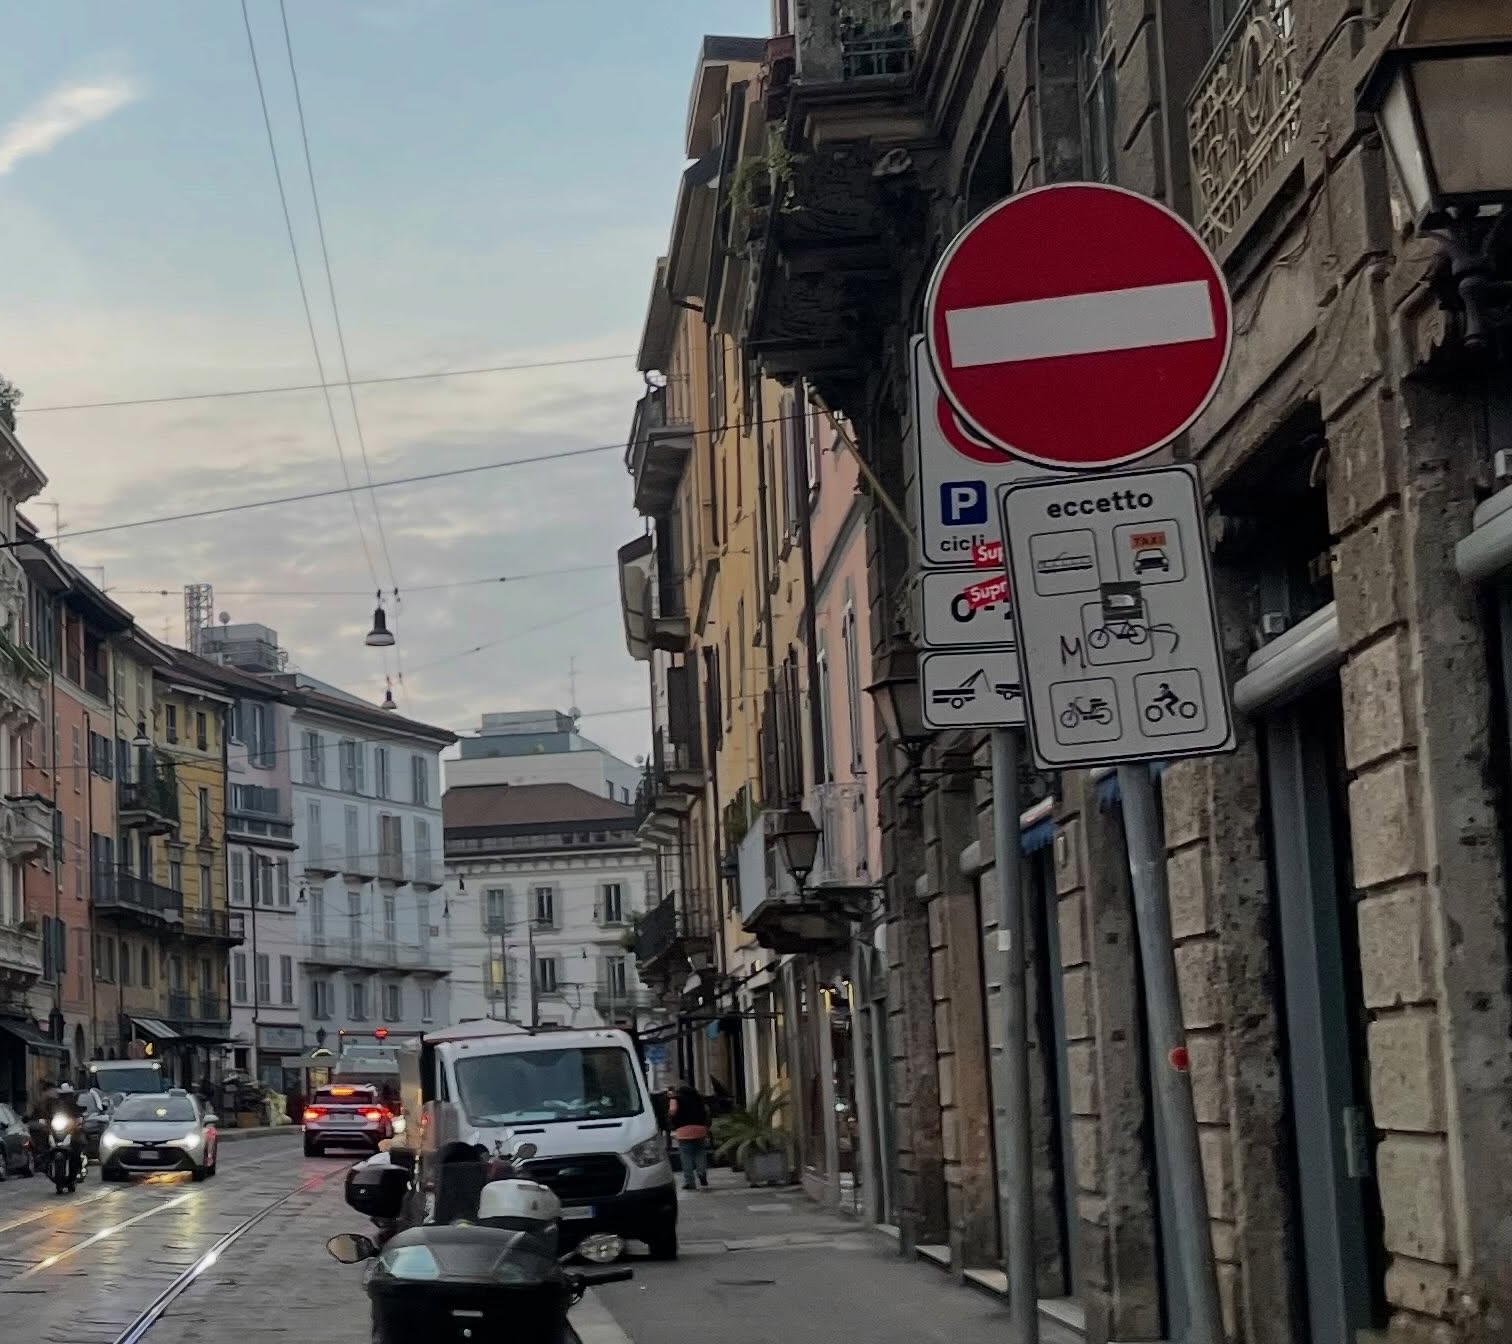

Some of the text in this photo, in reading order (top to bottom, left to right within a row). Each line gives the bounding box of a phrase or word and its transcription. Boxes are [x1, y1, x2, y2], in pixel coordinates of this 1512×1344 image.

[950, 487, 979, 521] P
[1046, 489, 1153, 519] eccetto
[1132, 534, 1166, 550] TAXI
